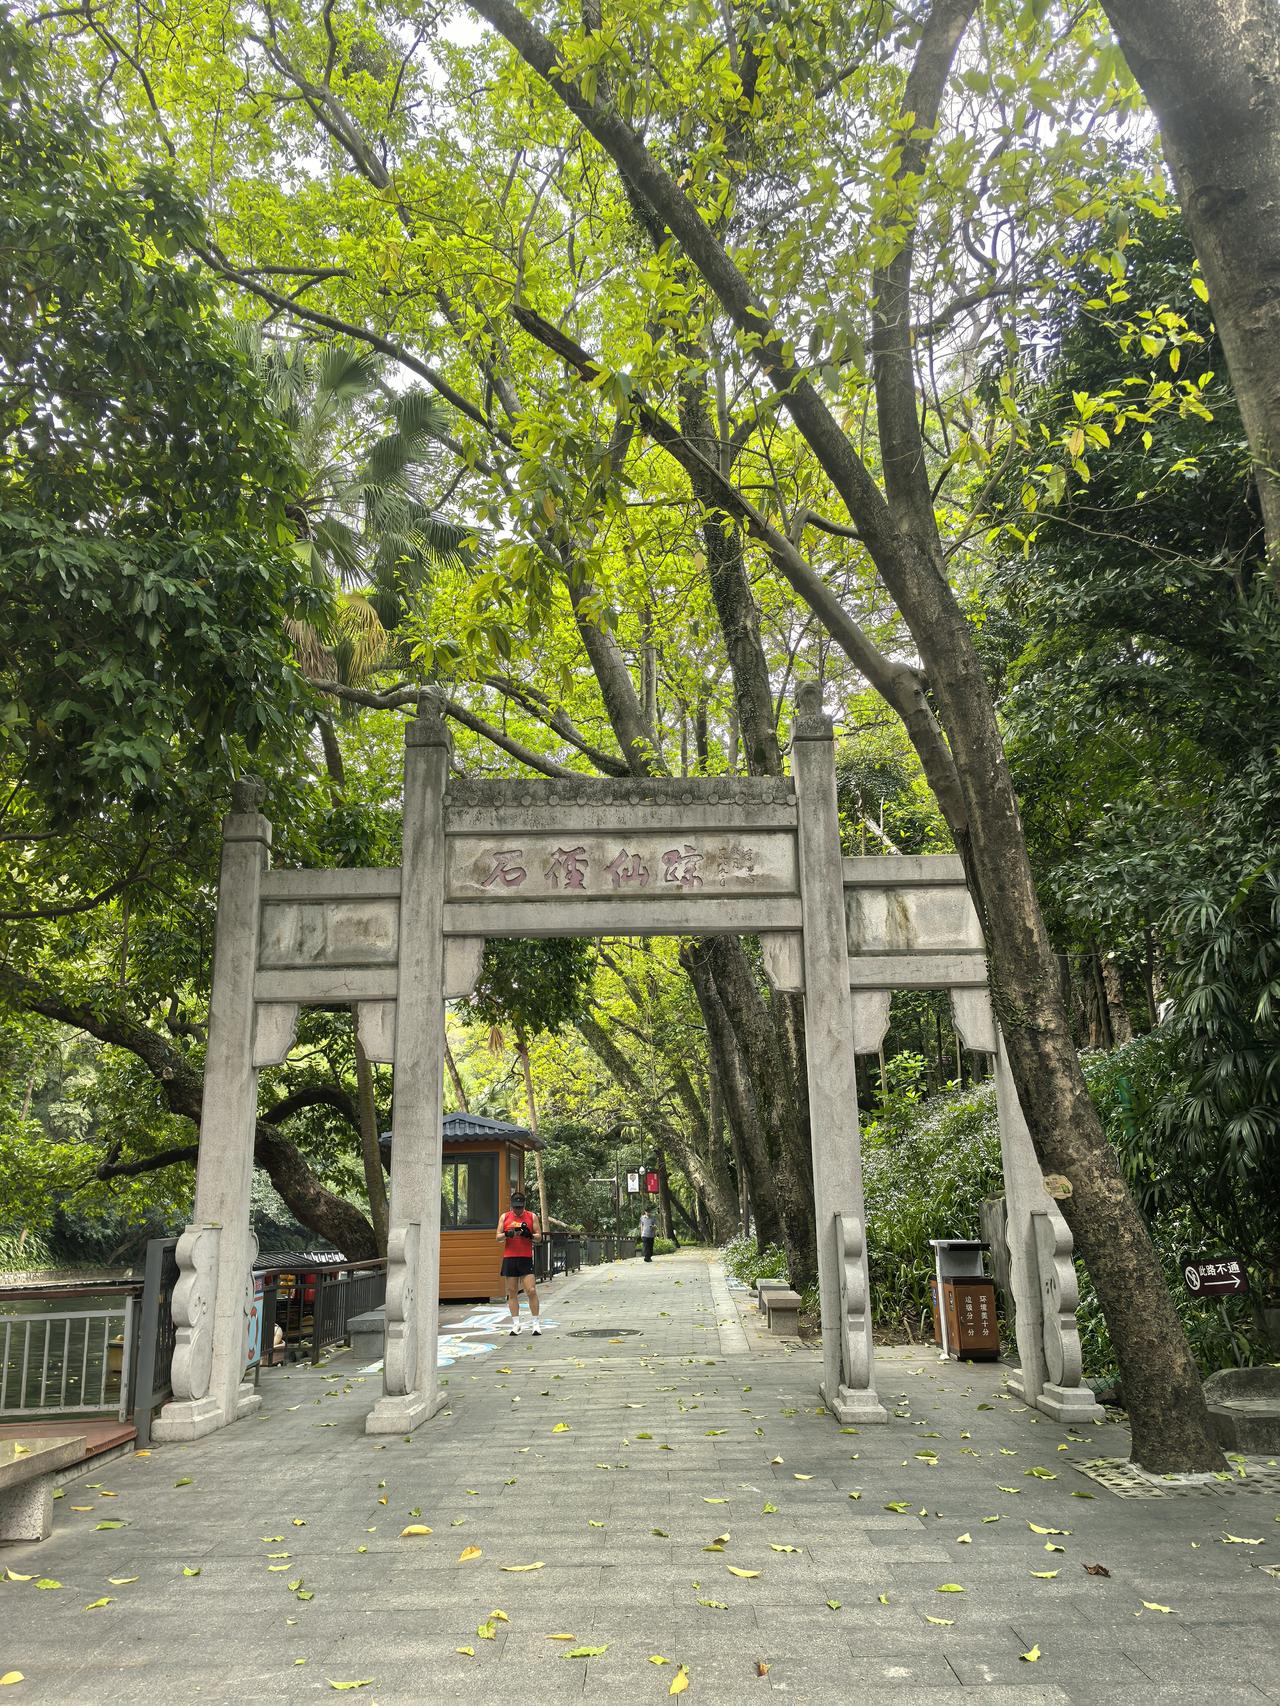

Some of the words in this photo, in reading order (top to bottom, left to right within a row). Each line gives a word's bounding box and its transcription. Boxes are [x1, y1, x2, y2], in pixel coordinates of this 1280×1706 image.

[1198, 1261, 1241, 1277] 此路不通
[979, 1295, 990, 1336] 环境美十分
